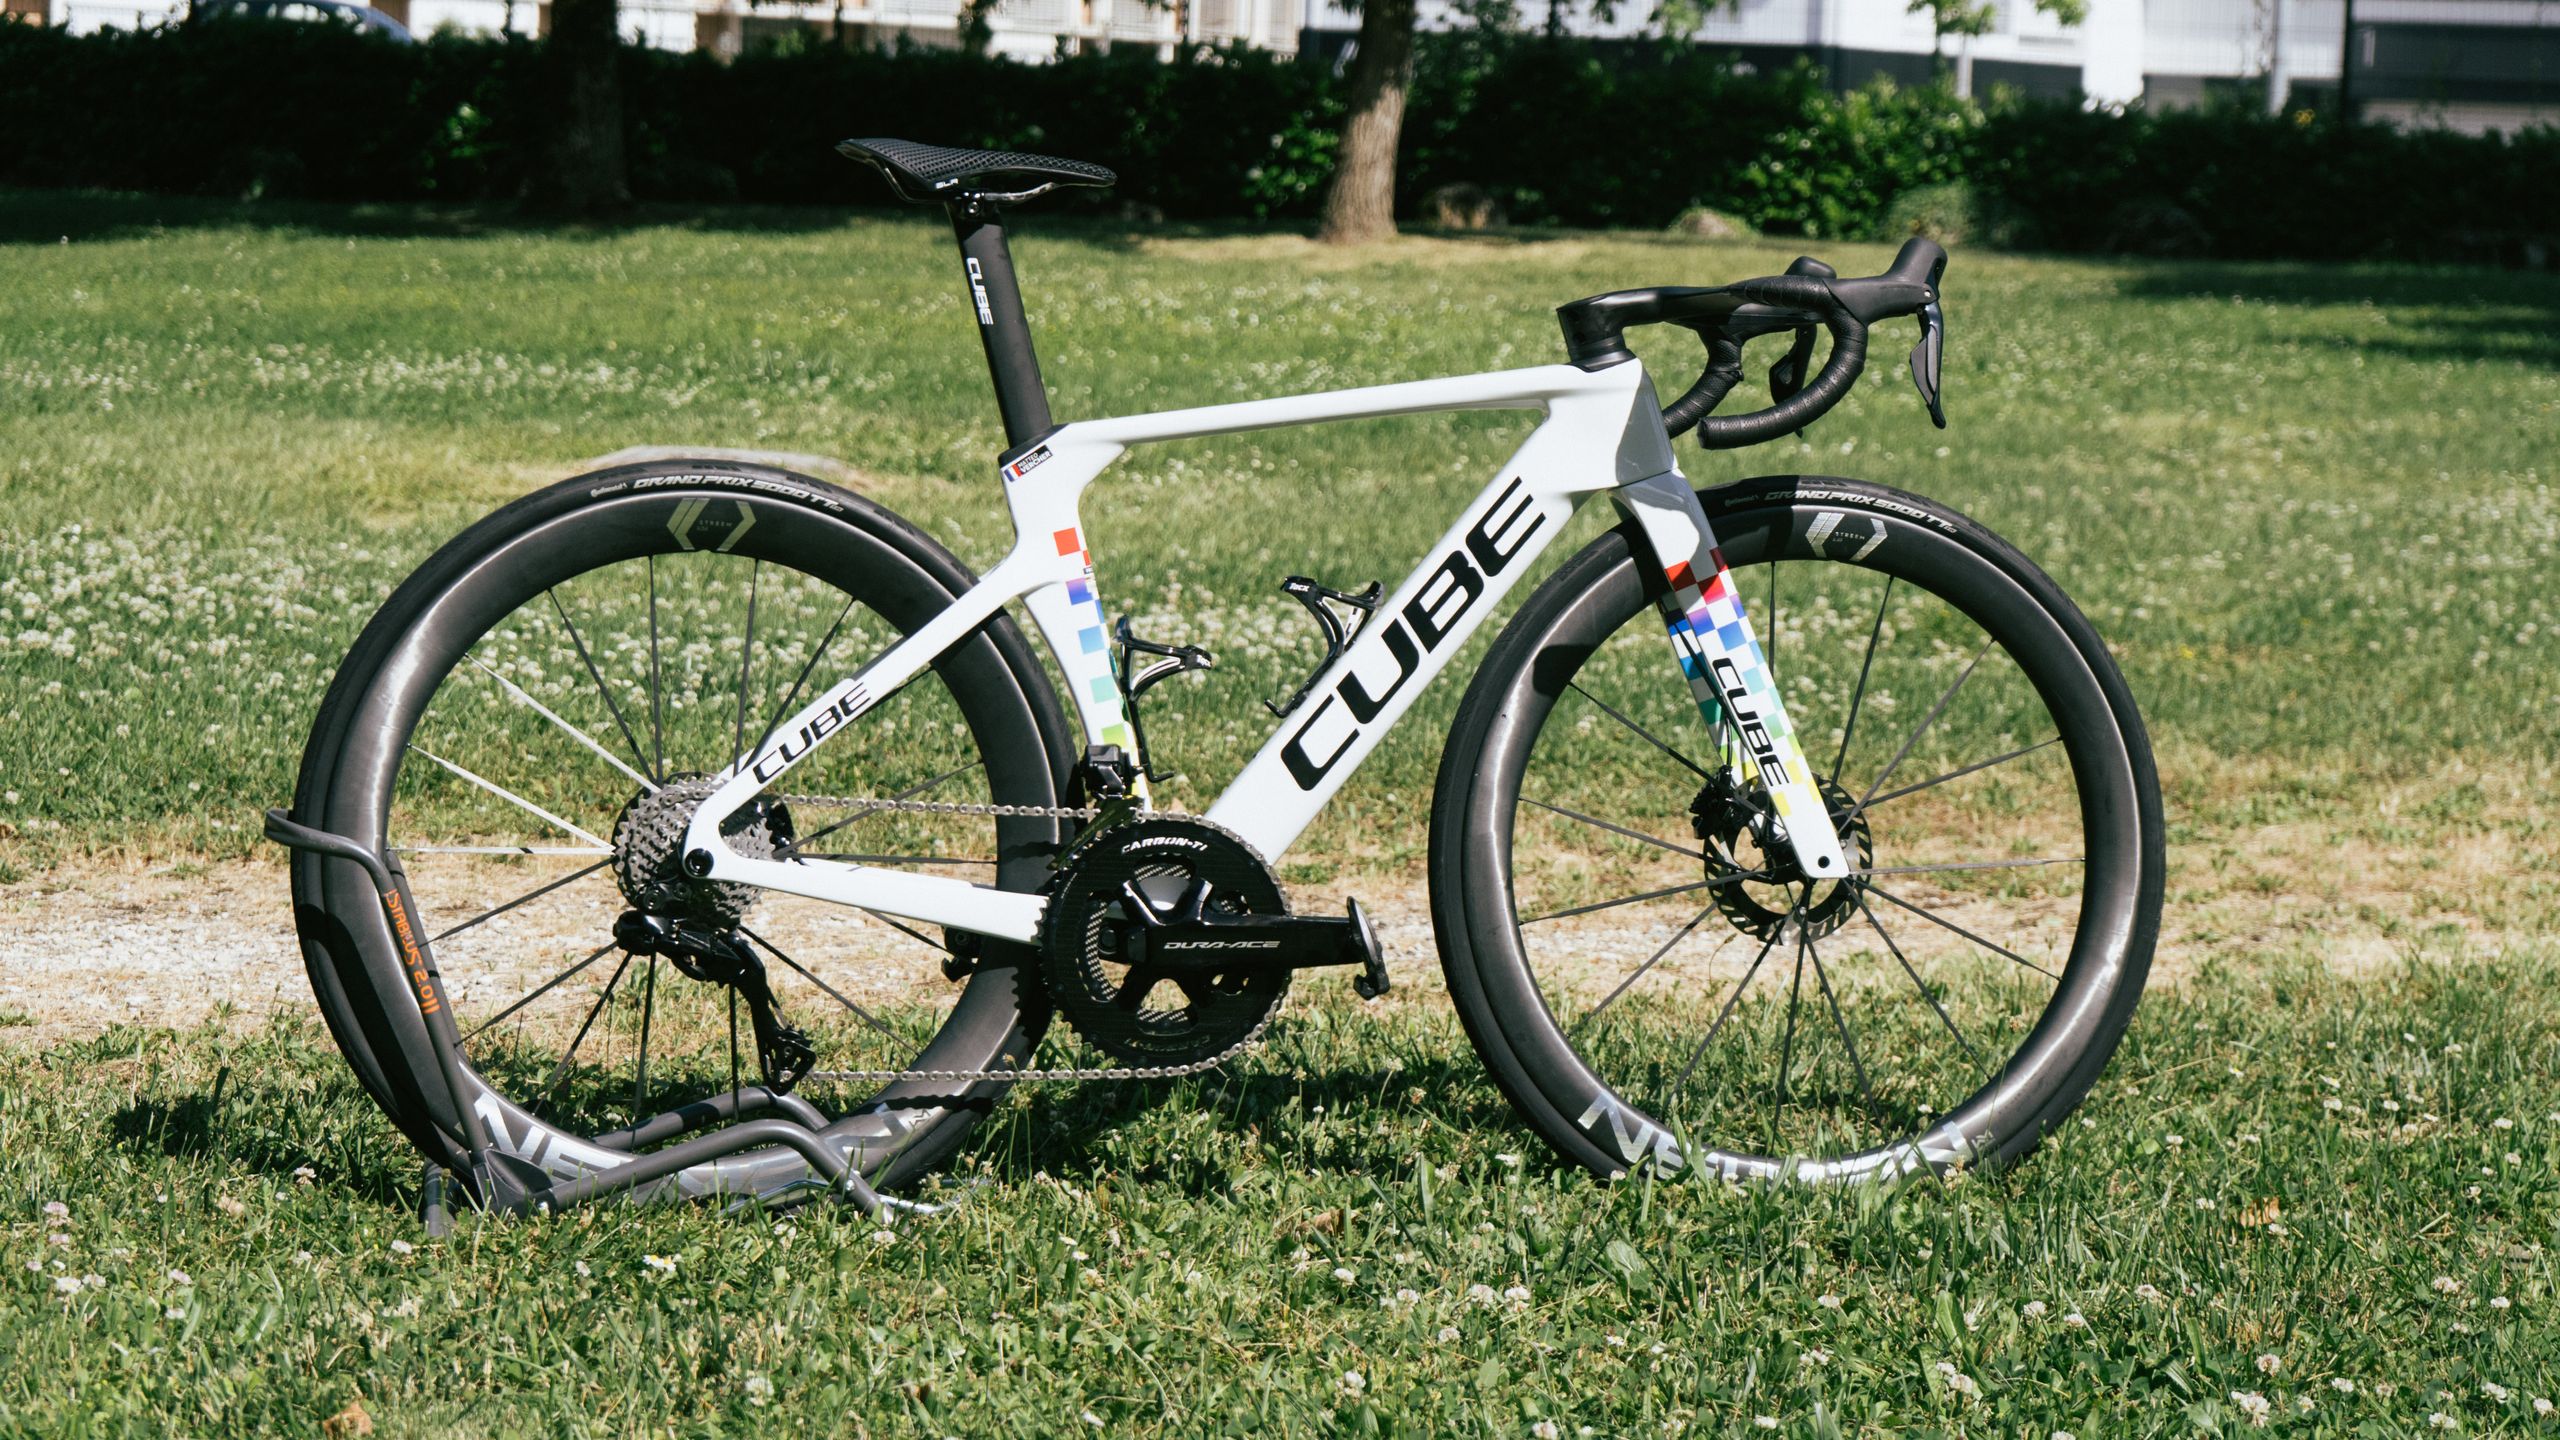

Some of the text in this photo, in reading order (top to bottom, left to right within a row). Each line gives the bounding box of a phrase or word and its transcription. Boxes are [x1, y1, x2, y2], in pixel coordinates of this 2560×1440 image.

[966, 257, 994, 326] CUBE
[1017, 452, 1039, 470] MATTEO
[1020, 450, 1052, 474] VERCHER
[633, 475, 702, 489] GRAND
[701, 475, 752, 487] PRIX
[751, 480, 810, 499] 5000
[1764, 490, 1829, 501] GRAND
[1827, 492, 1876, 505] PRIX
[1873, 499, 1928, 519] 5000
[1279, 475, 1547, 792] CUBE
[752, 681, 872, 785] CUBE
[1712, 657, 1790, 788] CUBE
[1163, 940, 1281, 950] DURA-ACE
